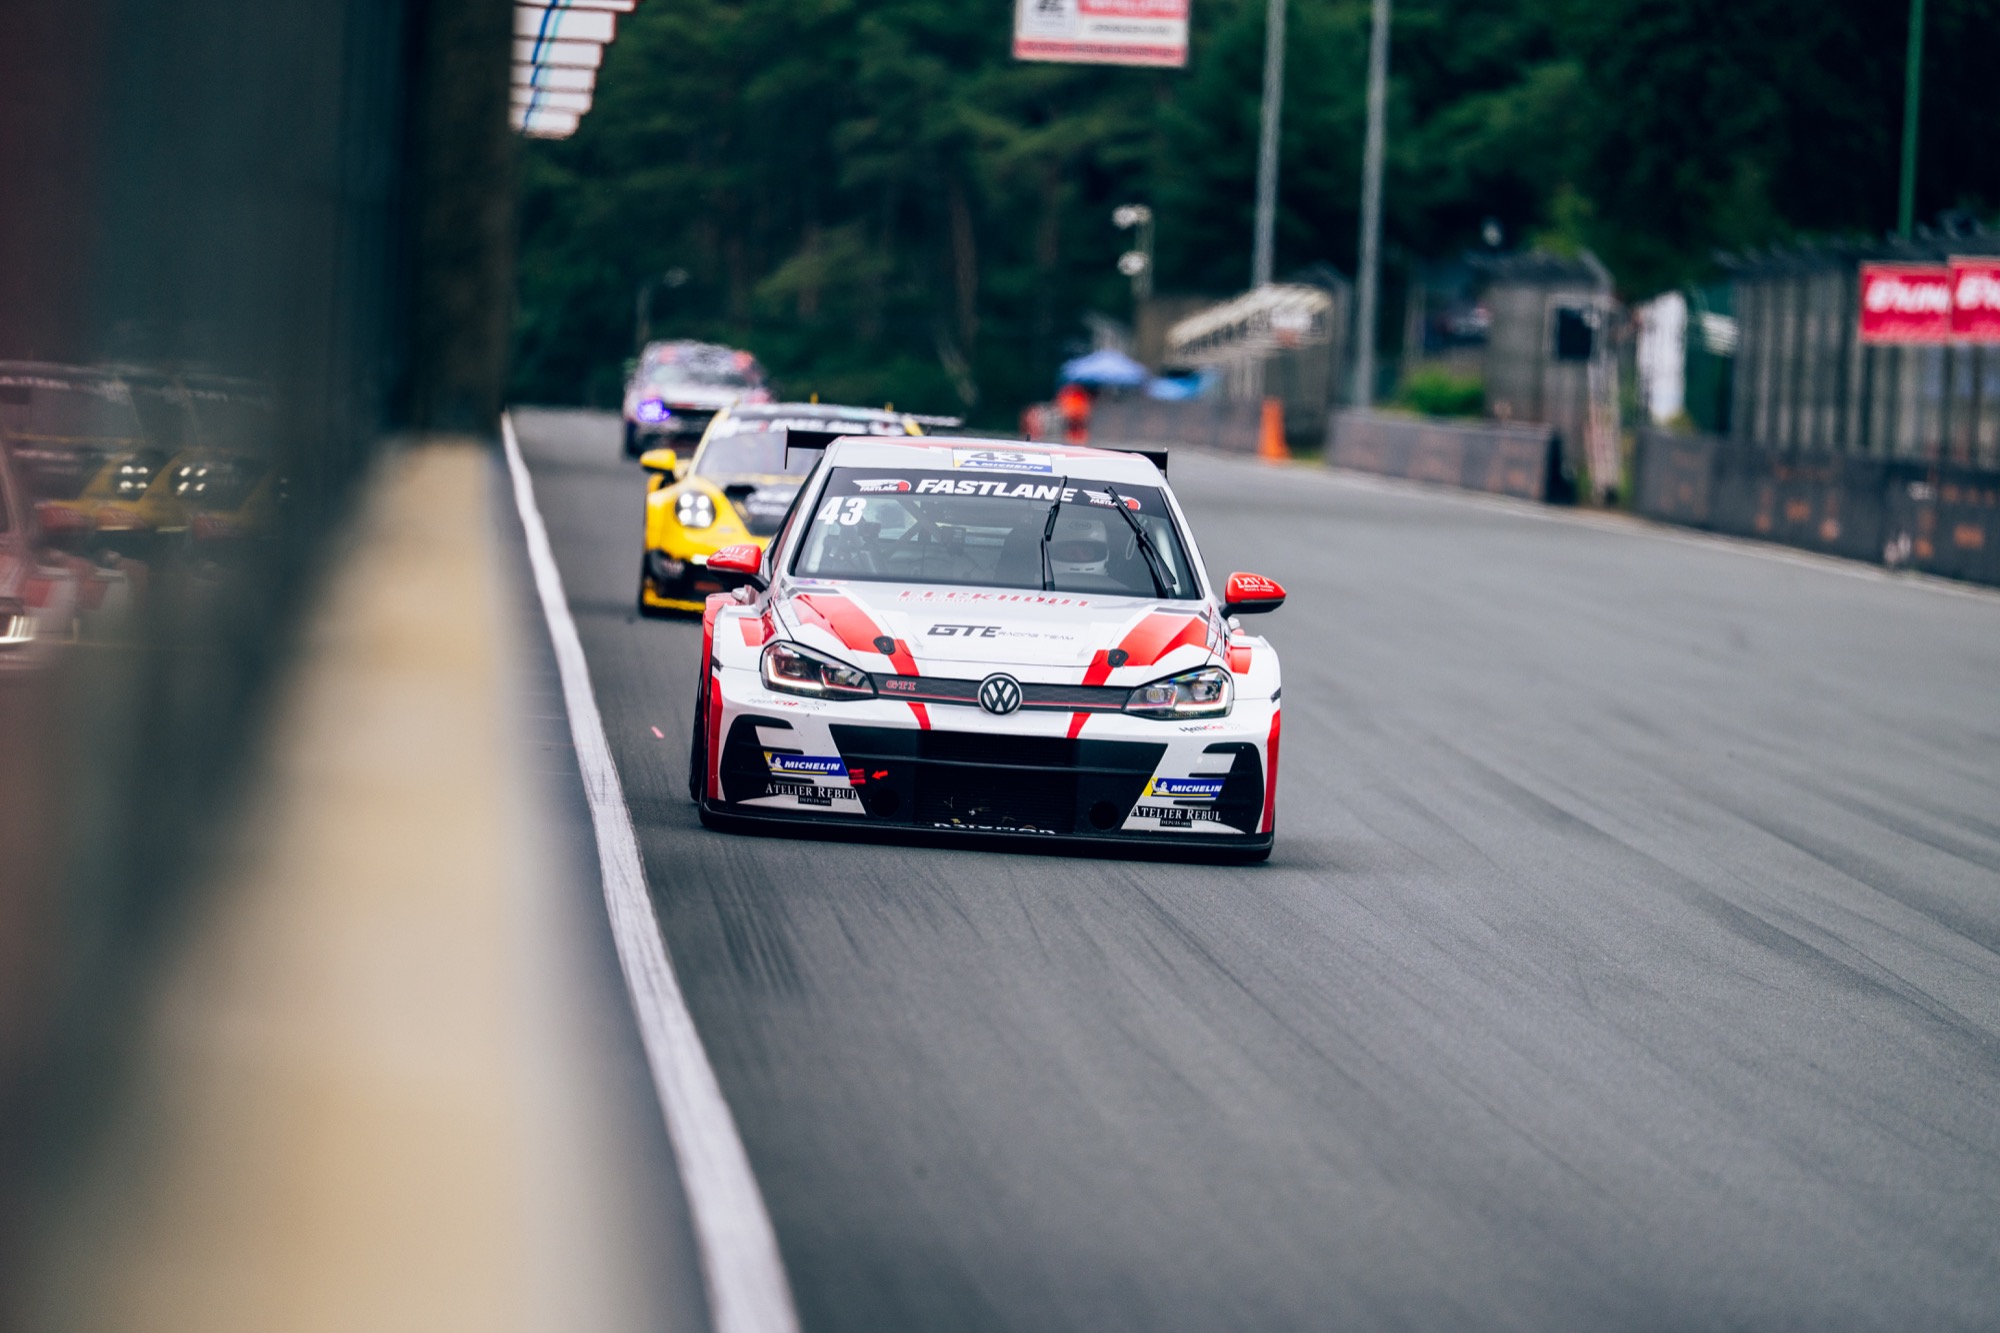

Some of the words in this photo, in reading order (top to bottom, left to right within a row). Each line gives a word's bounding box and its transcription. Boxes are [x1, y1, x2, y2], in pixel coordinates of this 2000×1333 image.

[970, 451, 1026, 462] 43
[981, 462, 1044, 470] MICHELIN
[915, 479, 1078, 502] FASTLANE
[817, 496, 867, 526] 43
[927, 623, 1002, 638] GTE
[886, 679, 917, 691] GTI
[784, 761, 841, 771] MICHELIN
[765, 783, 813, 796] ATELIER
[1131, 805, 1182, 819] ATELIER
[1186, 808, 1221, 821] REBUL
